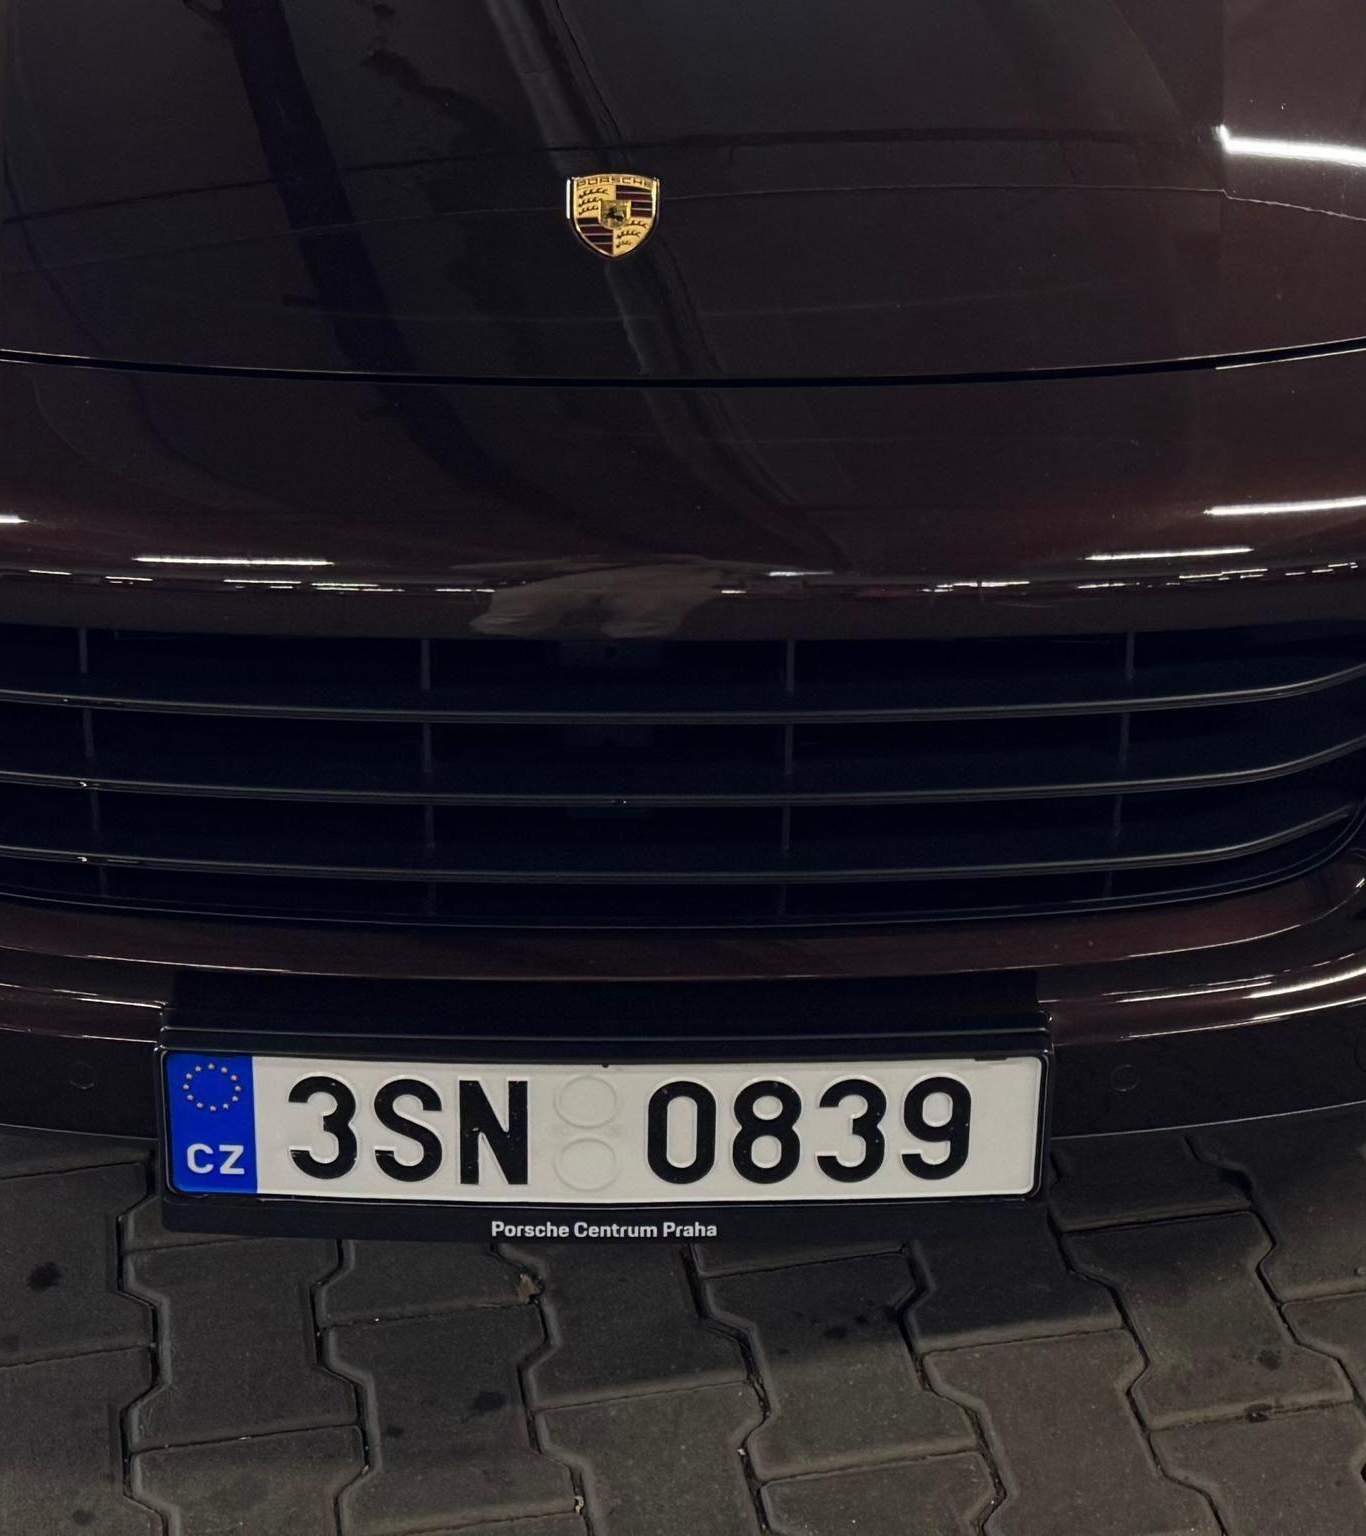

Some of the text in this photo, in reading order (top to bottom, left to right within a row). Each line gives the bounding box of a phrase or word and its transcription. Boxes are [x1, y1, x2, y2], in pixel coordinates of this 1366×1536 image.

[286, 1073, 973, 1186] 3SN 0839
[185, 1143, 246, 1177] CZ
[491, 1220, 717, 1238] Porsche Centrum Praha
